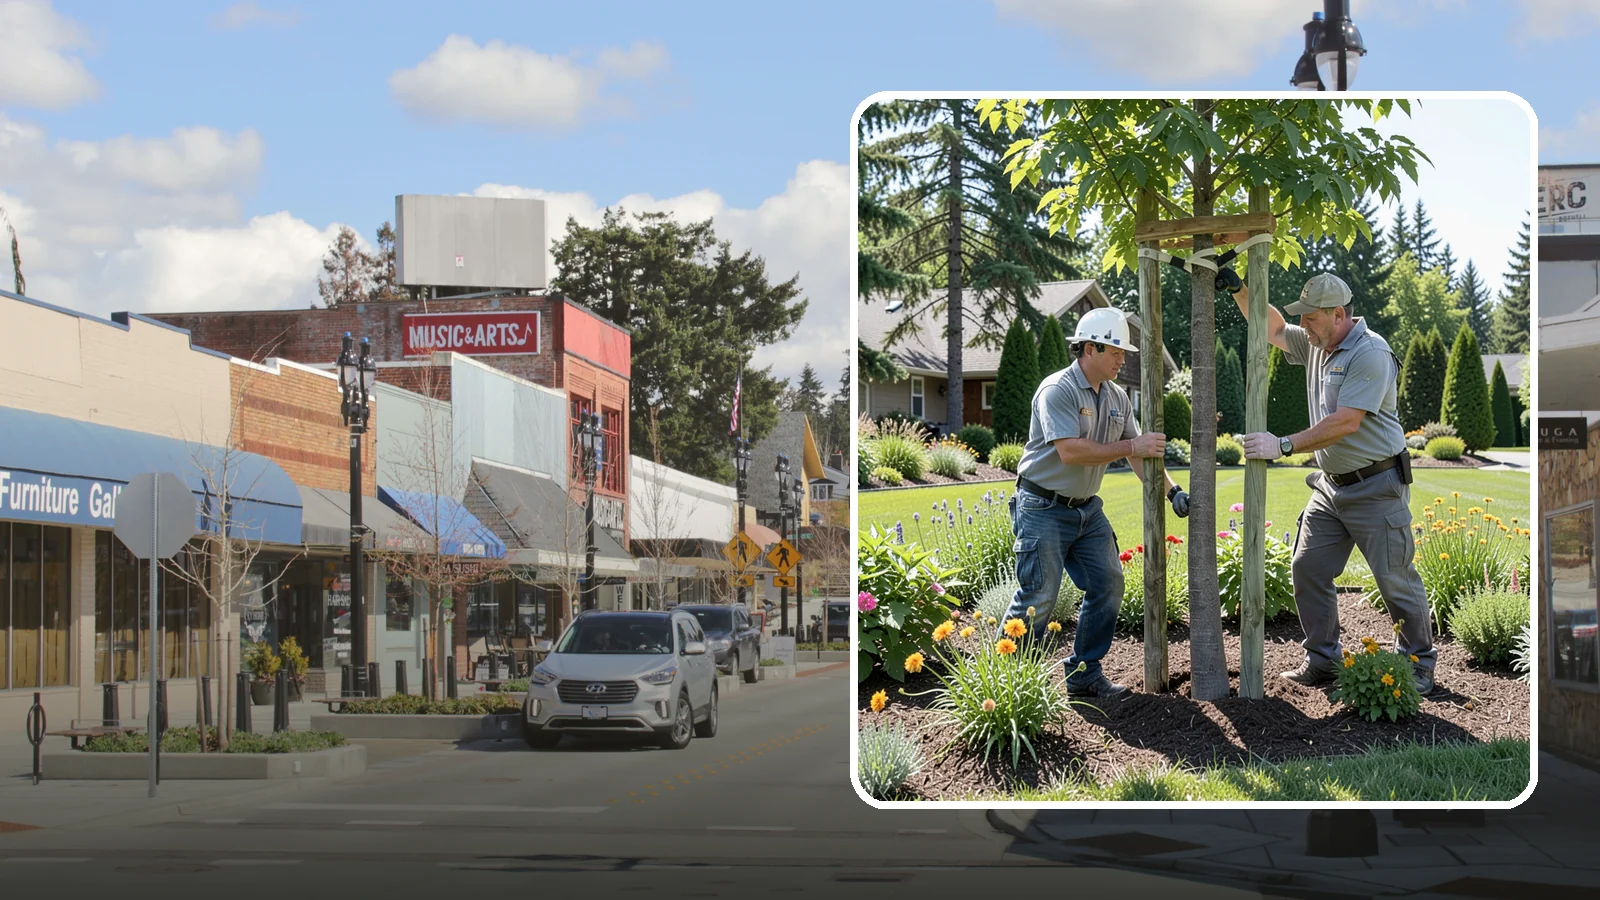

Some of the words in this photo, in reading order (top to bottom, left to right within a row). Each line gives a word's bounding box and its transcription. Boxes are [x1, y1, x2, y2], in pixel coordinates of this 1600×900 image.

[1540, 428, 1577, 437] UGA
[0, 471, 79, 515] Furniture
[89, 482, 122, 519] Gal
